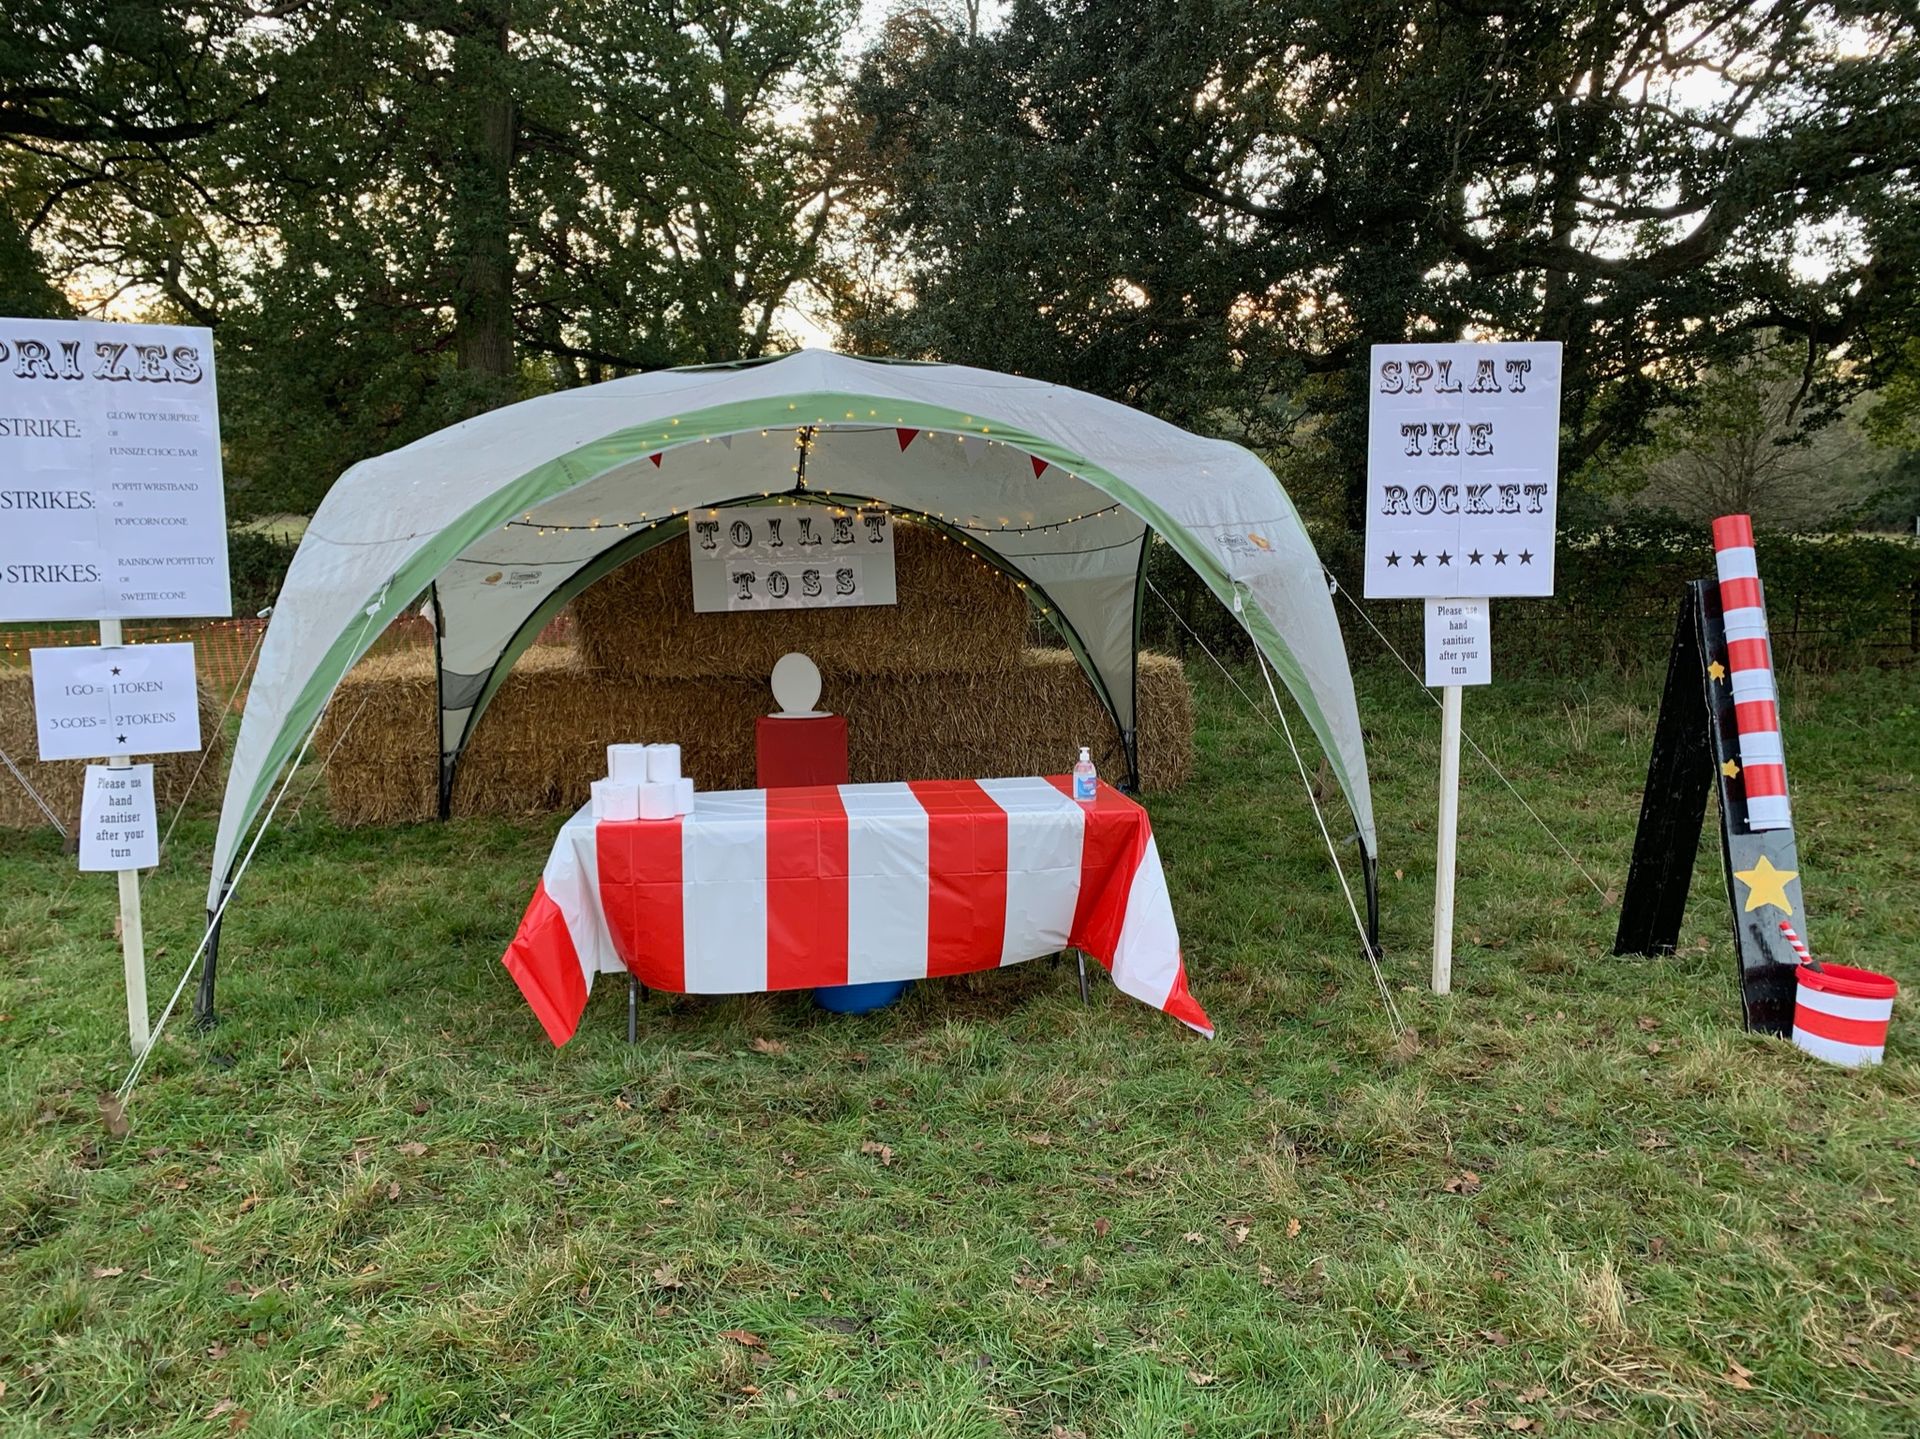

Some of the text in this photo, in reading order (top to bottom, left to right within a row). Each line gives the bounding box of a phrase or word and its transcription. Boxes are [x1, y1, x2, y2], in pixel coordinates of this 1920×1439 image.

[0, 339, 203, 384] RIZES
[1380, 358, 1531, 393] SPLAT
[106, 411, 200, 422] GLOW TOY SURPRISE
[0, 418, 81, 438] STRIKE:
[1400, 422, 1493, 456] THE
[109, 447, 147, 456] FUNSIZE
[178, 448, 199, 457] BAR
[111, 482, 199, 492] POPPIT WRISTBAND
[0, 491, 96, 509] STRIKES:
[1381, 483, 1547, 515] ROCKET
[114, 517, 189, 526] POPCORN CONE
[696, 515, 886, 550] TOILET
[118, 556, 216, 567] RAINBOW POPPIT TOY
[7, 564, 102, 583] STRIKES:
[732, 568, 856, 600] TOSS
[121, 591, 187, 601] SWEETIE CONE
[1437, 606, 1462, 616] Please
[1449, 620, 1468, 631] hand
[1442, 635, 1475, 646] sanitiser
[1439, 650, 1478, 662] after your
[1451, 666, 1467, 675] turn
[65, 685, 70, 696] 1
[71, 684, 94, 696] GO
[112, 684, 117, 694] 1
[118, 681, 163, 694] TOKEN
[50, 718, 59, 730] 3
[60, 717, 97, 729] GOES
[115, 715, 124, 726] 2
[125, 712, 176, 726] TOKENS
[97, 777, 142, 789] Please use
[109, 794, 133, 806] hand
[99, 811, 141, 824] sanitiser
[95, 829, 145, 842] after your
[110, 848, 131, 858] turn
